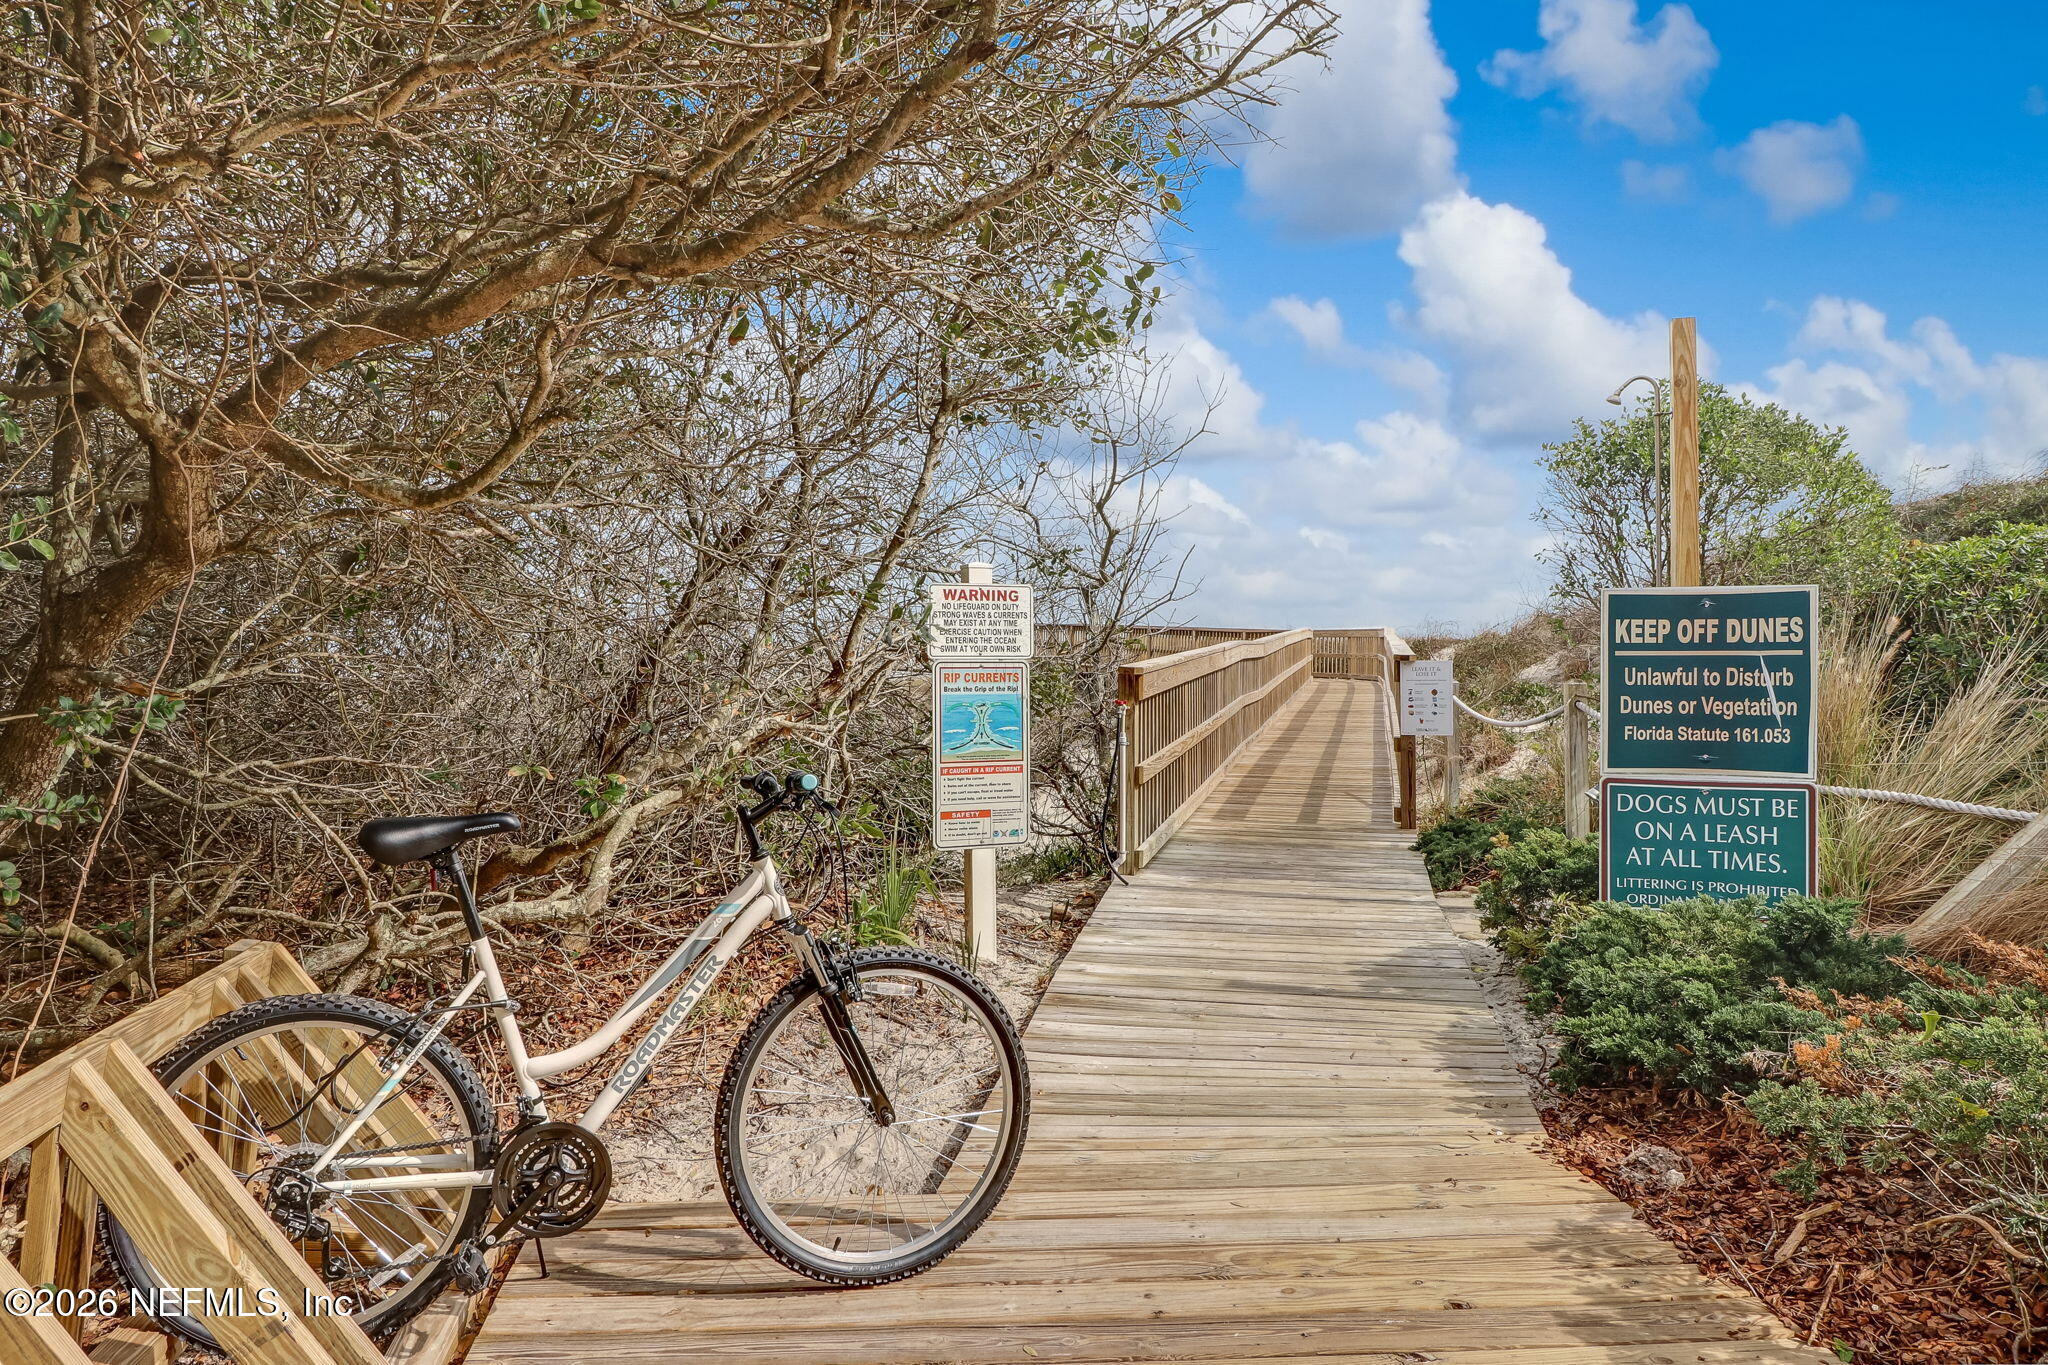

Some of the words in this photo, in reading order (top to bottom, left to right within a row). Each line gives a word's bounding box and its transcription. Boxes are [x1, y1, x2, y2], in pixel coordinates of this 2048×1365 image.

[943, 589, 1019, 602] WARNING
[1615, 618, 1671, 644] KEEP
[1677, 618, 1719, 644] OFF
[1727, 617, 1804, 643] DUNES
[1006, 645, 1021, 653] RISK
[943, 673, 961, 683] RIP
[964, 672, 1019, 683] CURRENTS
[1624, 667, 1698, 686] Unlawful
[1703, 667, 1720, 686] to
[1726, 667, 1794, 686] Disturb
[1620, 696, 1673, 715] Dunes
[1678, 700, 1697, 715] or
[1701, 696, 1798, 720] Vegetation
[1624, 726, 1673, 741] Florida
[1677, 726, 1729, 742] Statute
[1734, 728, 1791, 744] 161.053
[1617, 793, 1686, 814] DOGS
[1694, 797, 1764, 817] MUST
[1772, 799, 1799, 818] BE
[464, 823, 500, 833] ROADMASTER
[1635, 820, 1673, 841] ON
[1680, 823, 1697, 842] A
[1704, 823, 1778, 845] LEASH
[1626, 847, 1655, 866] AT
[1660, 848, 1702, 868] ALL
[1707, 850, 1788, 874] TIMES.
[1616, 878, 1687, 891] LITTERING
[1692, 881, 1704, 892] IS
[611, 954, 724, 1094] ROADMASTER
[406, 1017, 447, 1066] ROADMASTER
